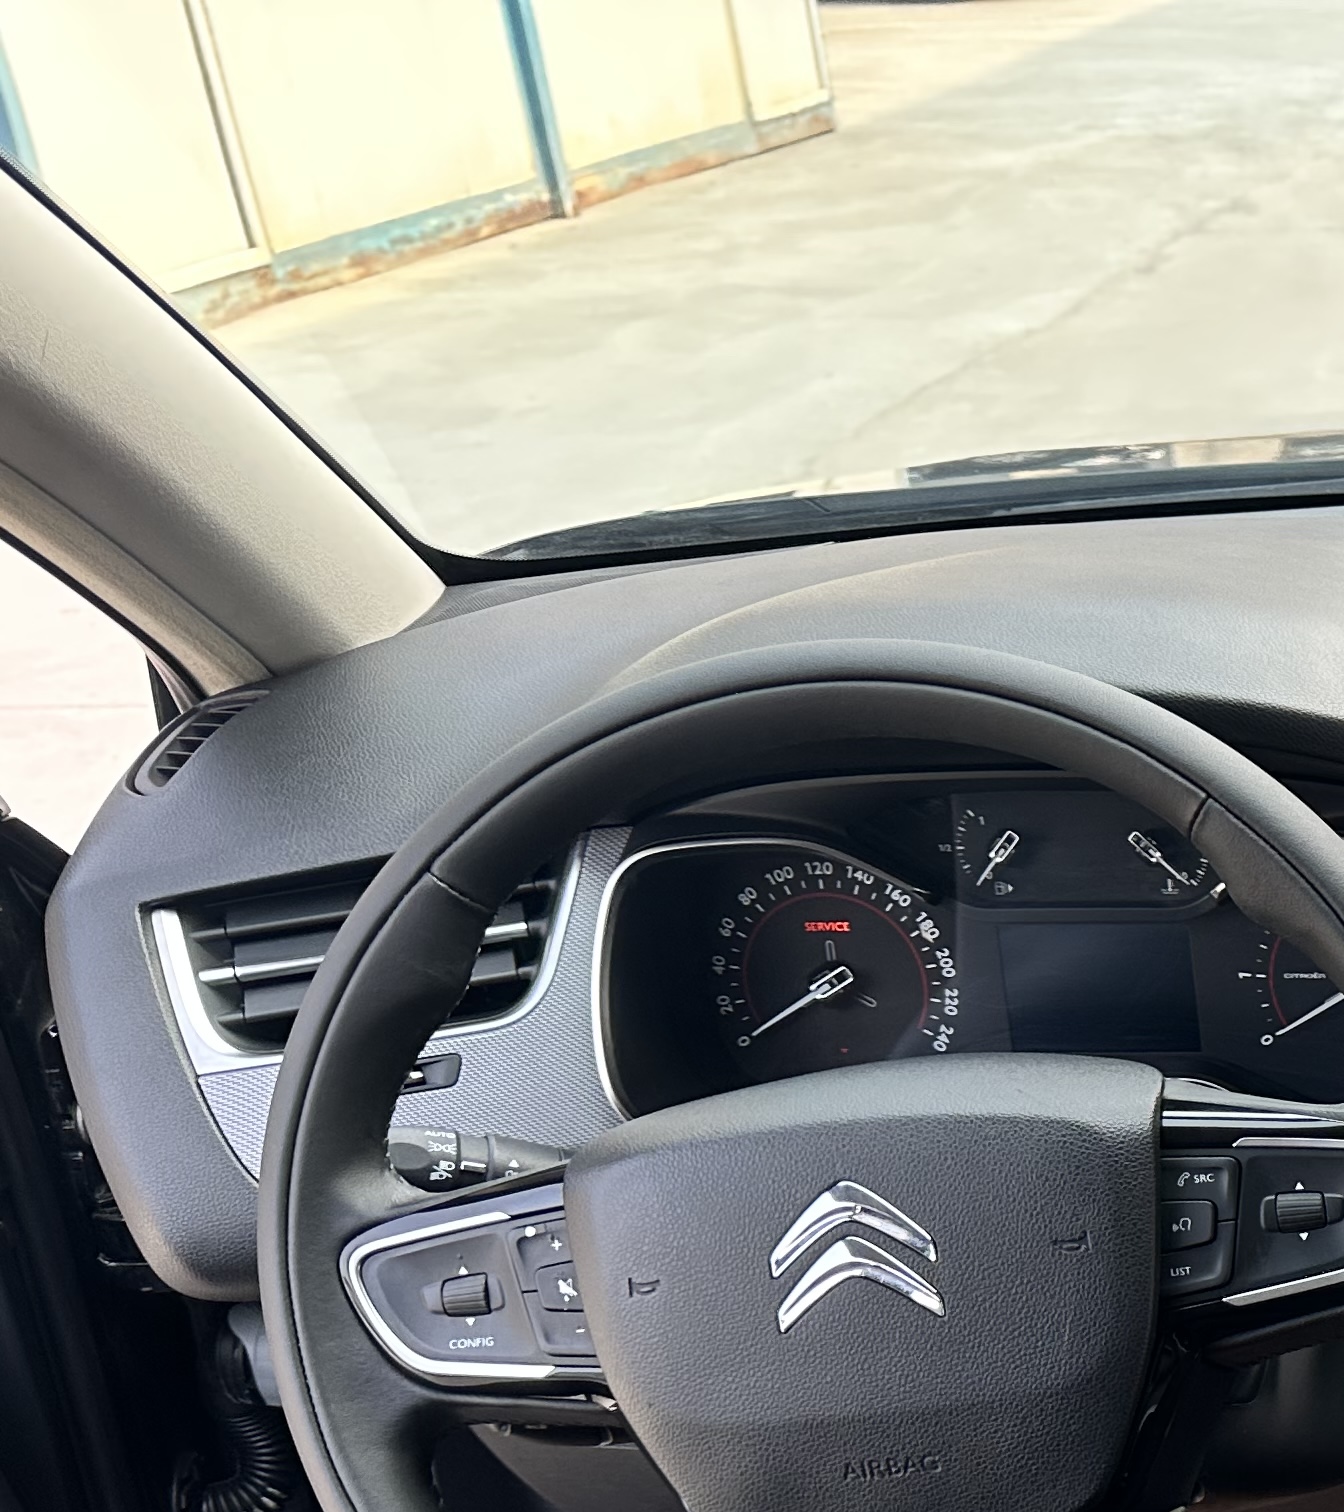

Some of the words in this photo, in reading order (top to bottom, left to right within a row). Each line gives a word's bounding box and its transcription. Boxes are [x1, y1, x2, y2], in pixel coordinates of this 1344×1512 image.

[764, 865, 795, 886] 100
[804, 861, 834, 876] 120
[845, 865, 875, 886] 140
[737, 886, 758, 906] 80
[883, 882, 912, 908] 160
[718, 917, 736, 937] 60
[804, 920, 851, 933] SERVICE
[915, 911, 941, 940] 180
[711, 955, 727, 975] 40
[935, 948, 957, 978] 200
[1237, 971, 1253, 980] 1
[716, 995, 734, 1016] 20
[943, 988, 960, 1017] 220
[736, 1035, 751, 1047] 0
[932, 1024, 955, 1052] 240
[1259, 1034, 1274, 1046] 0
[424, 1130, 457, 1139] AUTO
[1193, 1173, 1216, 1184] SRC
[1169, 1266, 1192, 1277] LIST
[448, 1336, 495, 1350] CONFIG
[843, 1455, 943, 1481] AIRBAG
